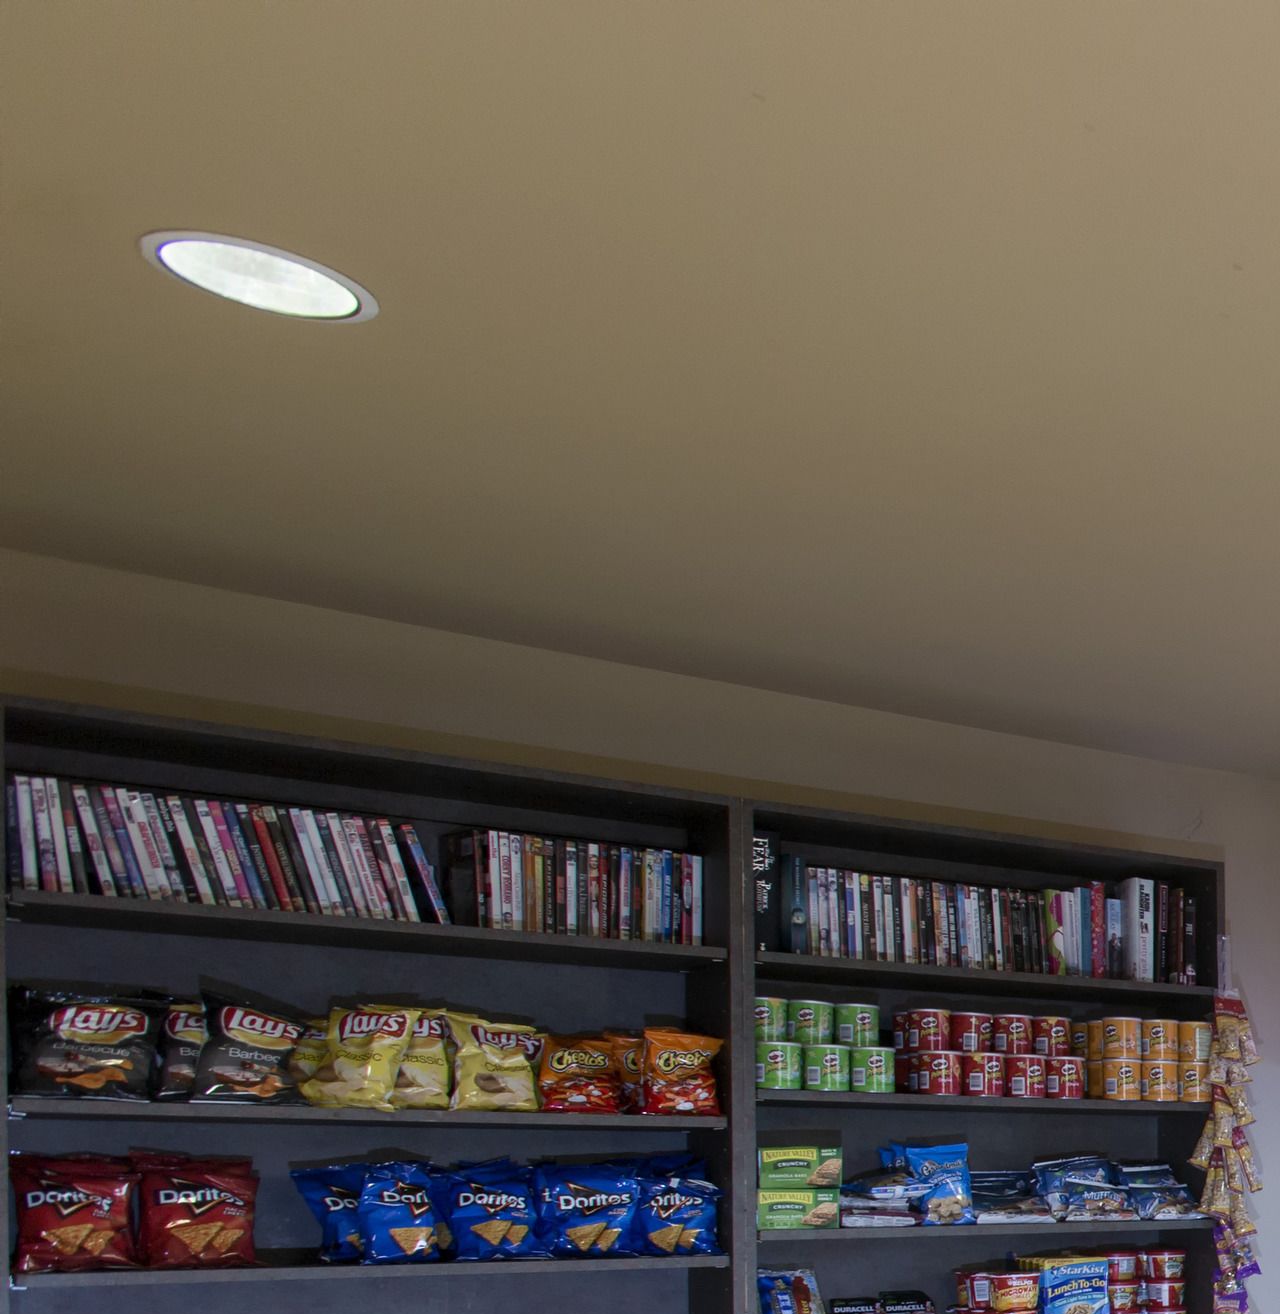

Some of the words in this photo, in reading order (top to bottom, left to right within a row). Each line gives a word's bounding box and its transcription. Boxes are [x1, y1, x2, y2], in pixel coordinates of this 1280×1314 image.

[753, 837, 768, 872] FEAR
[229, 1048, 281, 1063] Barbec
[553, 1049, 607, 1069] Cheetos
[658, 1049, 707, 1069] Cheet
[765, 1150, 789, 1159] NATURE
[790, 1150, 816, 1159] VALLEY
[27, 1190, 112, 1211] Doritos
[160, 1187, 244, 1206] Doritos
[384, 1189, 428, 1204] Dori
[459, 1192, 526, 1210] Doritos
[560, 1192, 631, 1210] Doritos
[651, 1194, 702, 1208] oritos
[761, 1193, 786, 1202] NATURE
[787, 1192, 811, 1202] VALLEY
[1059, 1265, 1105, 1275] StarKist
[1048, 1280, 1078, 1297] Lunch
[833, 1306, 874, 1314] DURACELL
